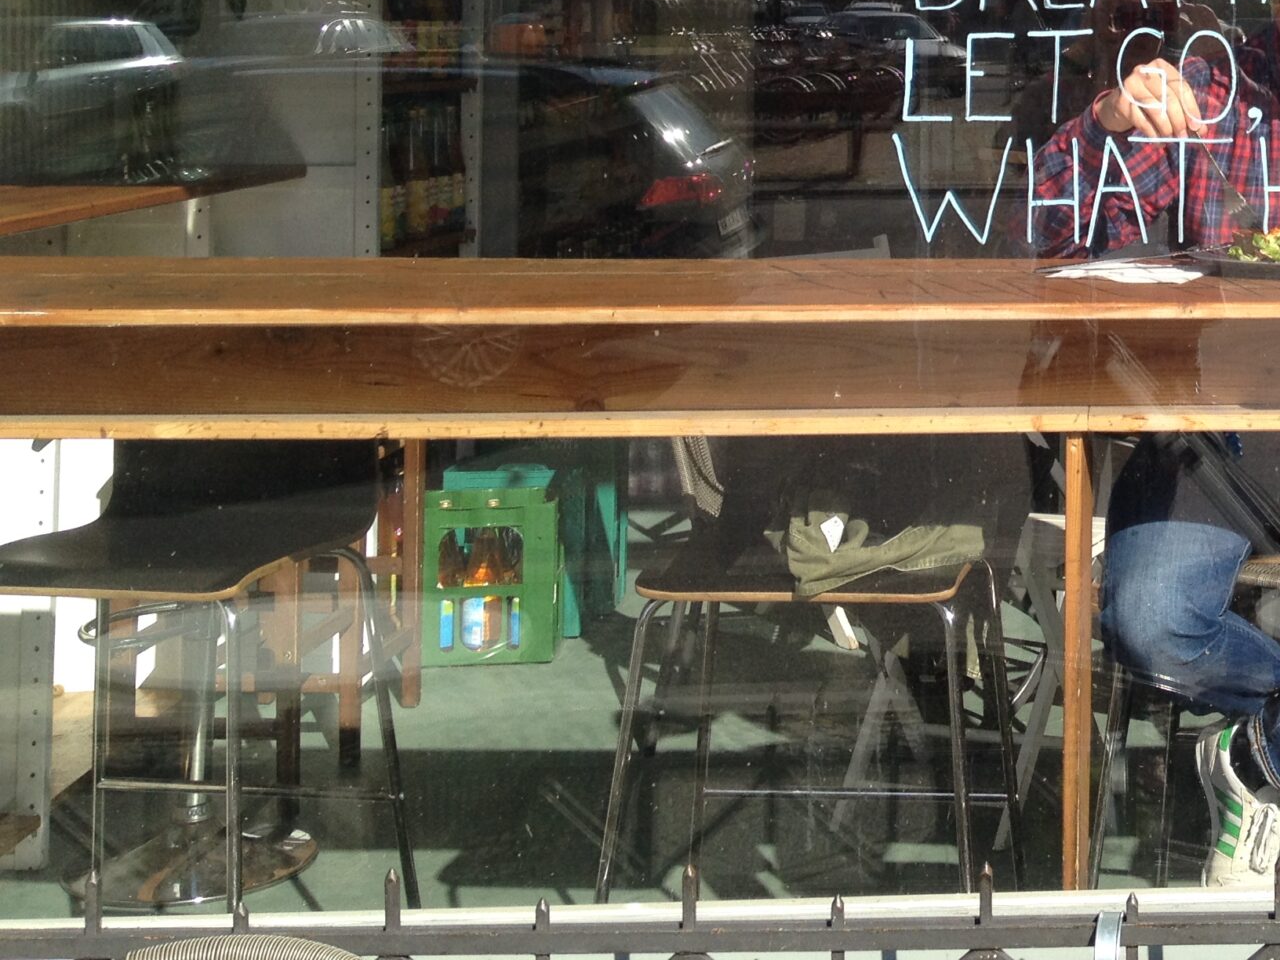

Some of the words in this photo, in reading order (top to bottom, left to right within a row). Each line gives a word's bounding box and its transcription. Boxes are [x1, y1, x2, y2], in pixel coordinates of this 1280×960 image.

[902, 29, 1094, 124] LET
[1116, 27, 1264, 134] GO,
[892, 133, 1233, 248] WHAT
